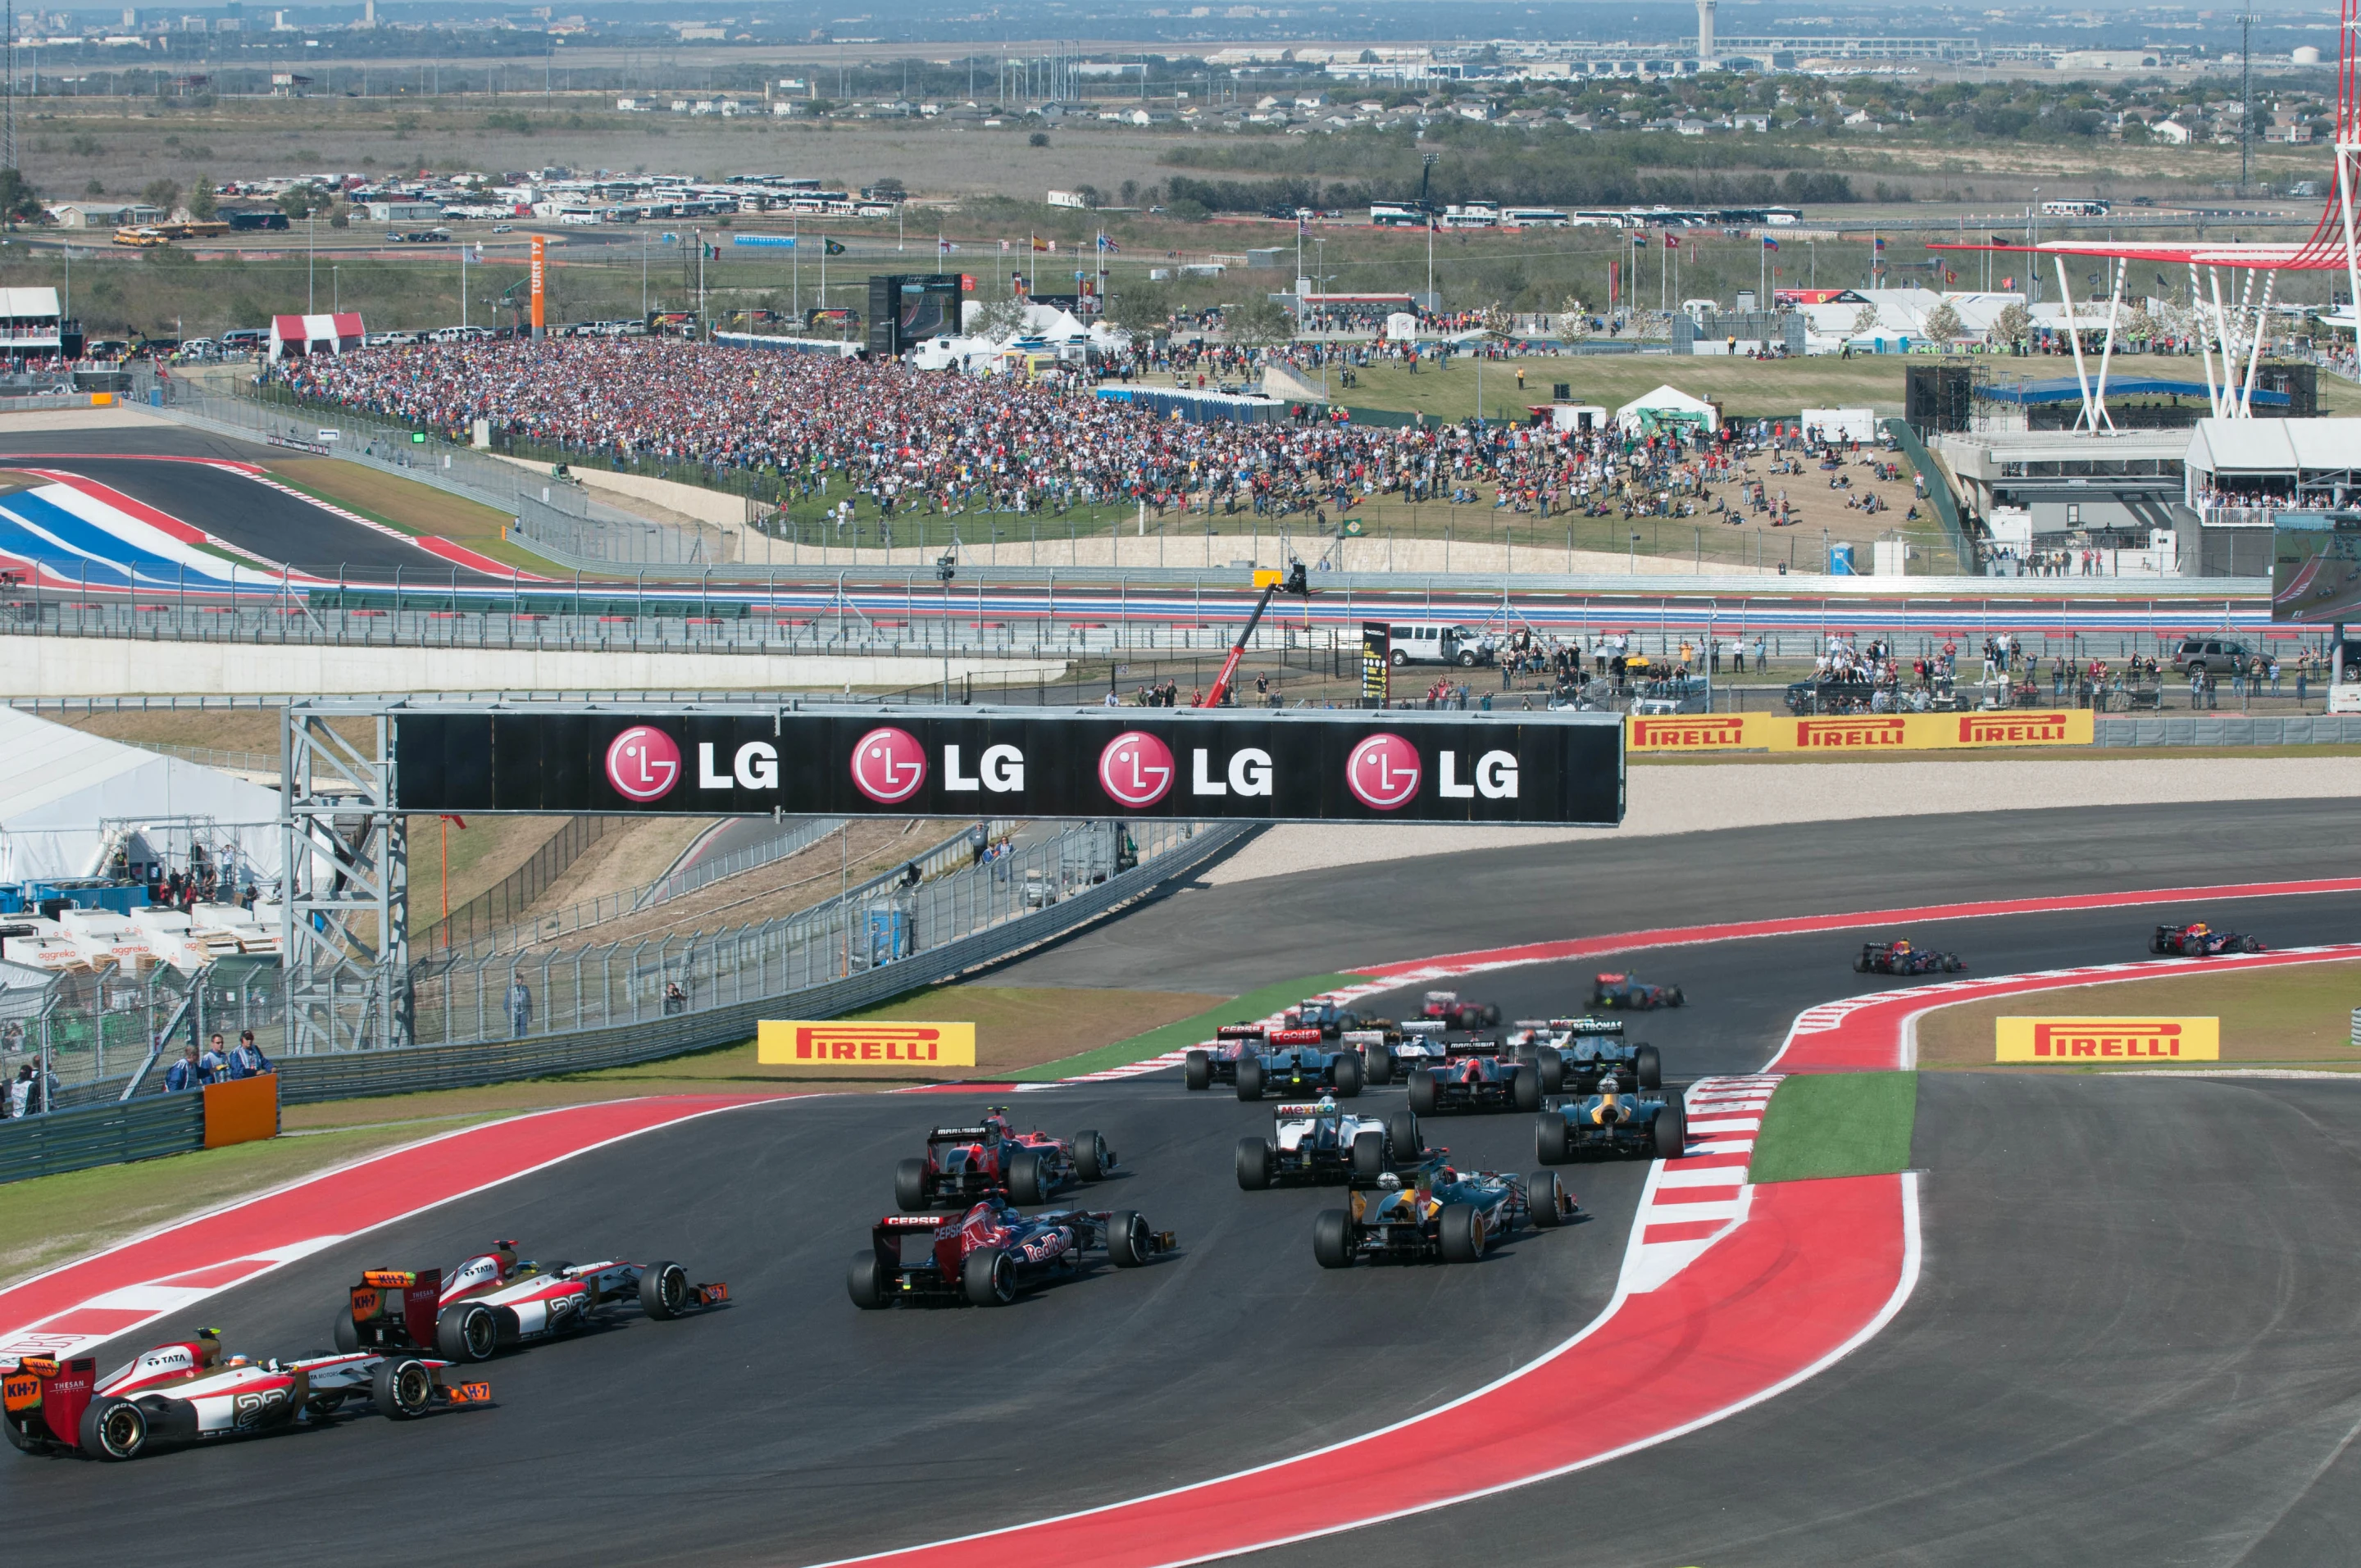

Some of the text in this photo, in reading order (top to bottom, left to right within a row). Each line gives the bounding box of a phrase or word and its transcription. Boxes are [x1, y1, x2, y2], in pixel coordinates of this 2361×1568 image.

[532, 241, 542, 295] TURN 19
[1633, 718, 1744, 747] PIRELLI
[1797, 718, 1906, 747] PIRELLI
[1958, 714, 2067, 743] PIRELLI
[699, 742, 778, 789] LG
[944, 744, 1025, 793] LG
[1193, 748, 1272, 797] LG
[1440, 750, 1518, 798] LG
[39, 951, 75, 961] aggreko
[111, 945, 149, 955] aggreko
[1573, 1021, 1622, 1030] PETRONAS
[796, 1027, 939, 1060] PIRELLI
[2035, 1024, 2181, 1056] PIRELLI
[937, 1127, 986, 1135] MARUSSIA
[888, 1216, 940, 1225] CEPSA
[934, 1222, 962, 1242] CEPSA
[474, 1263, 494, 1274] TATA
[354, 1293, 375, 1309] KH-7
[412, 1289, 434, 1298] THESAN
[161, 1353, 186, 1364] TATA
[54, 1379, 84, 1390] THESAN
[318, 1371, 339, 1379] MOTORS
[7, 1380, 38, 1398] KH-7
[103, 1402, 128, 1422] ZERO
